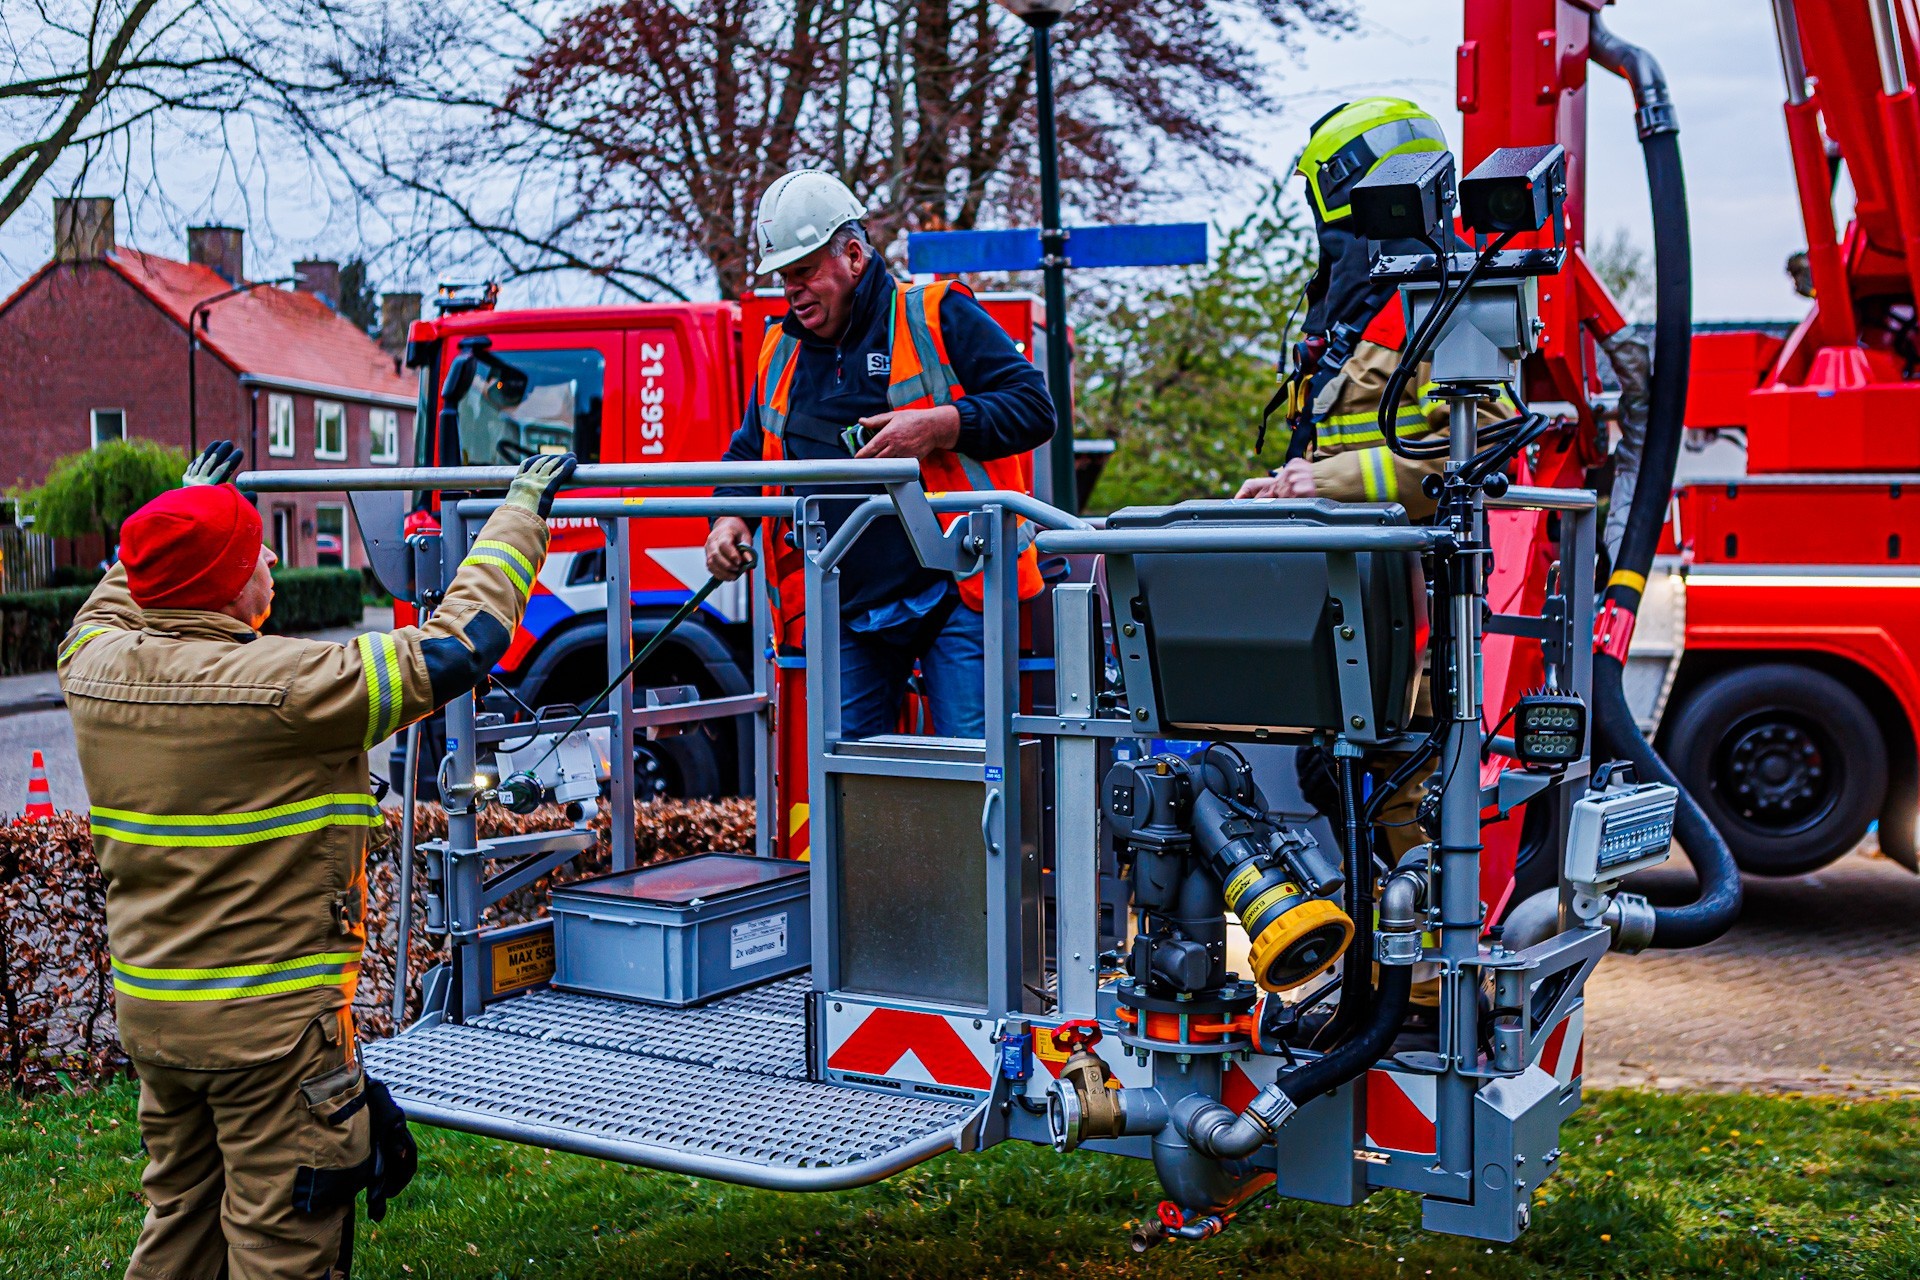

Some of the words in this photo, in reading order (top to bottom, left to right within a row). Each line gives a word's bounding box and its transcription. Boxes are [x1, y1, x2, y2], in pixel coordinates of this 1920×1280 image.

[641, 343, 664, 455] 21-3951
[1245, 900, 1266, 923] ELKHART
[509, 949, 533, 967] MAX
[536, 945, 552, 960] 550
[736, 949, 744, 959] 2x
